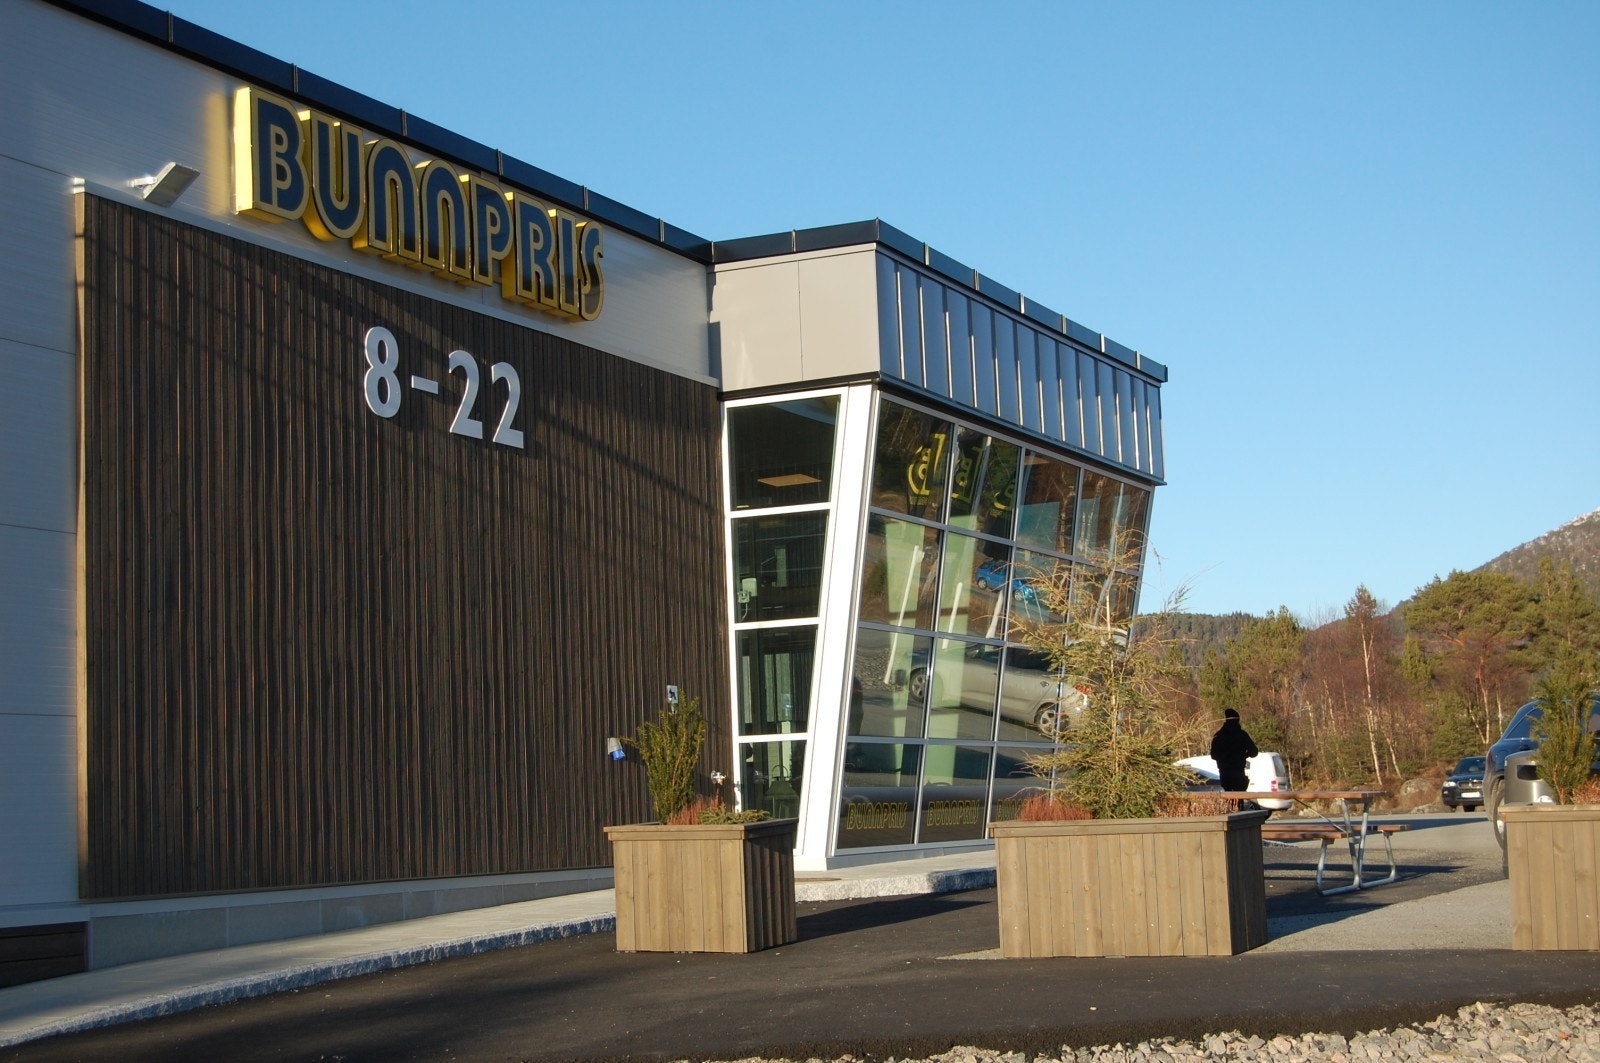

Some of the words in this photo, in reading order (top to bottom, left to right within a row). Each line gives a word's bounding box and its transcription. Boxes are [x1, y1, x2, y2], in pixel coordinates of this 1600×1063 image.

[235, 86, 604, 322] BUNNPRIS
[847, 801, 907, 830] BUNNPRIS
[927, 800, 979, 827] BUNNPRIS
